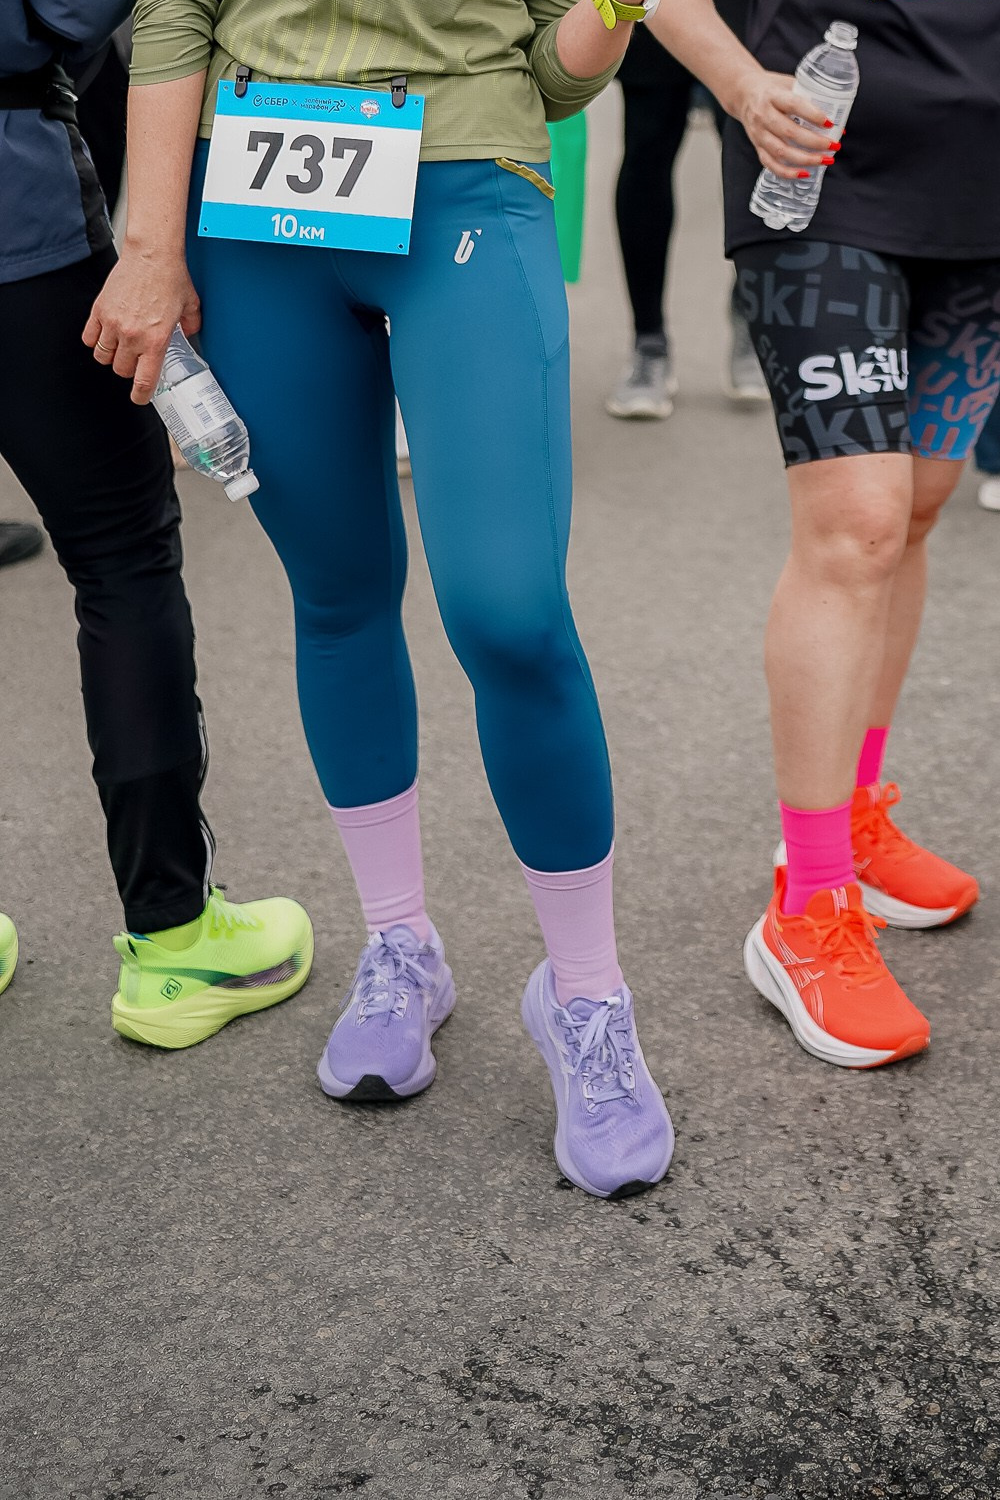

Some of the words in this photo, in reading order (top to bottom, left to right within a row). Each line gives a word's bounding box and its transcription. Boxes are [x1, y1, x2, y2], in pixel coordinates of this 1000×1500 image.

[264, 97, 289, 106] СБЕР
[246, 130, 374, 198] 737
[271, 213, 298, 238] 10
